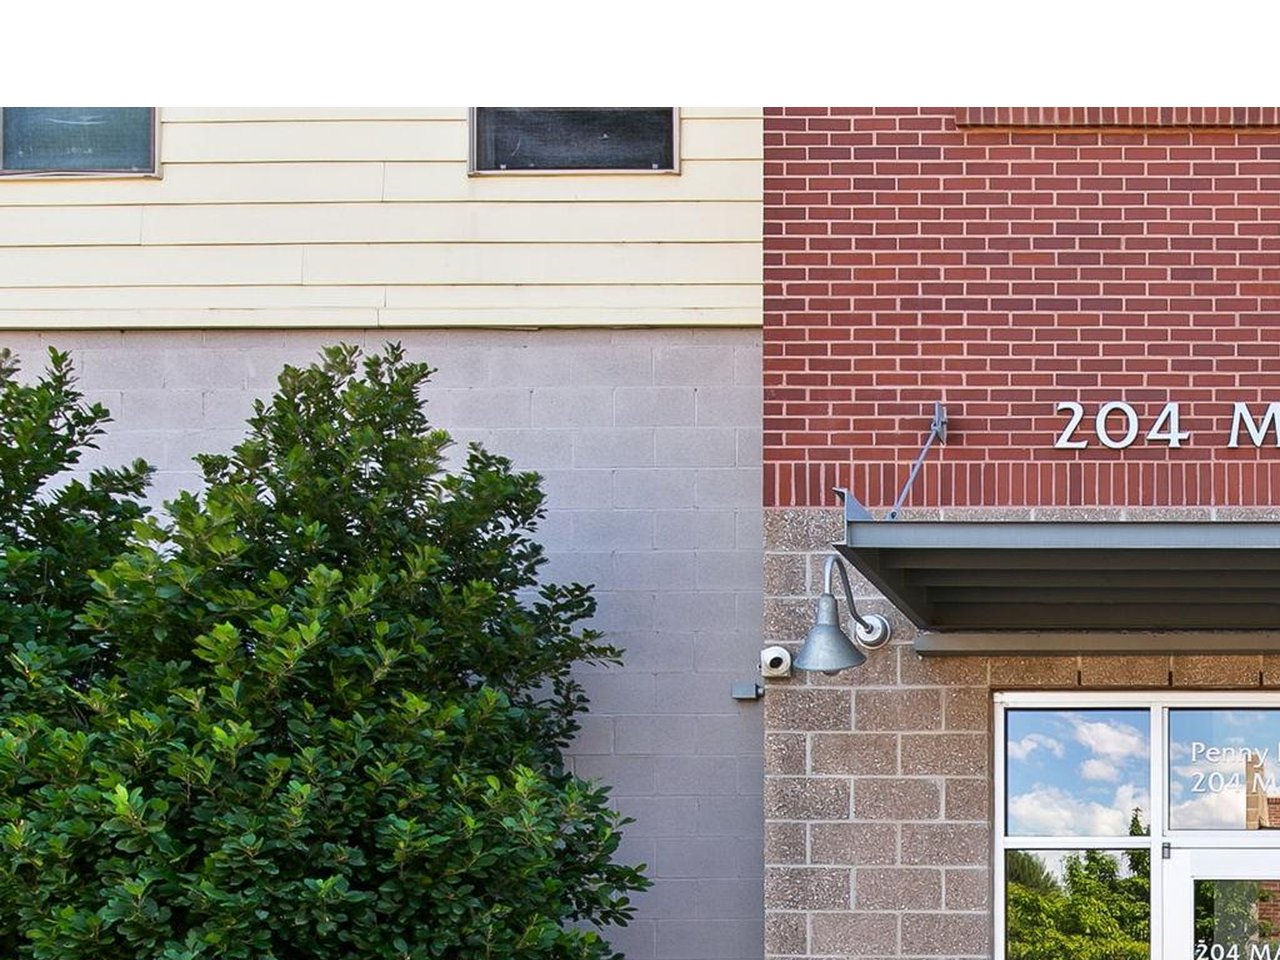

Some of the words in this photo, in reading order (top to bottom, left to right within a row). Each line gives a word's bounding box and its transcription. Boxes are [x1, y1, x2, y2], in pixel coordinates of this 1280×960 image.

[1053, 401, 1191, 449] 204
[1191, 741, 1268, 767] Penny
[1191, 771, 1241, 793] 204
